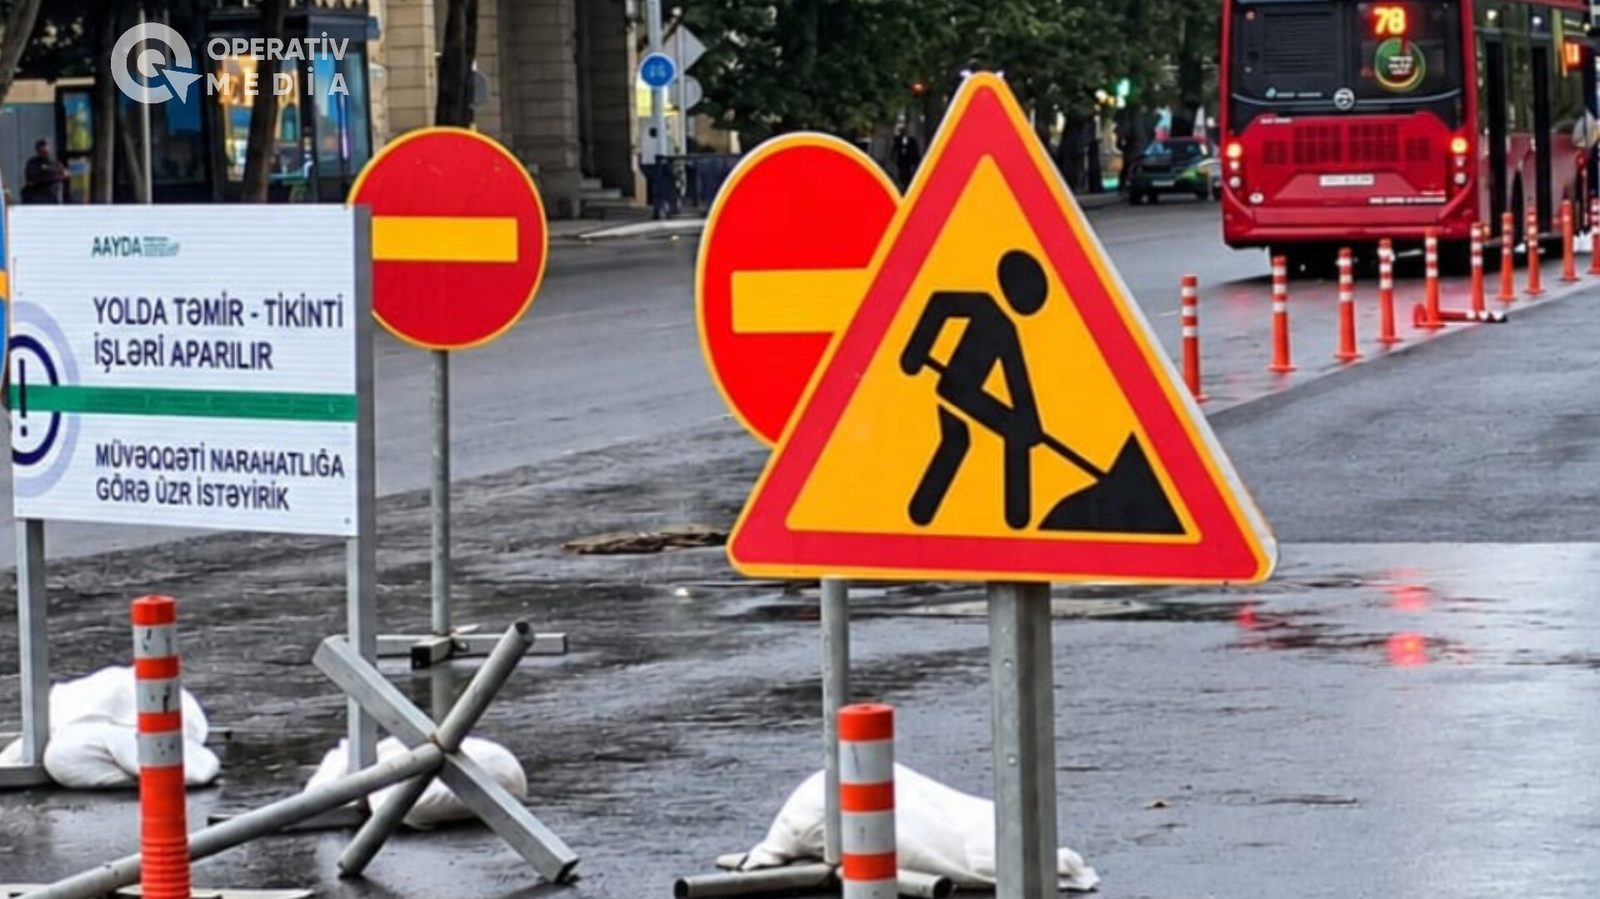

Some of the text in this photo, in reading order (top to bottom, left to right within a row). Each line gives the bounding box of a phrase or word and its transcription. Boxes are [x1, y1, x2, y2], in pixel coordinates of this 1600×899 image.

[1373, 6, 1406, 35] 78
[91, 235, 142, 257] AAYDA
[94, 296, 168, 326] YOLDA
[173, 290, 244, 327] TƏMİR
[264, 292, 343, 328] TİKİNTİ
[94, 332, 273, 373] İŞLƏRİ APARILIR
[96, 440, 345, 478] MÜVƏQQƏTİ NARAHATLIĞA
[96, 473, 290, 511] GÖRƏ ÜZR İSTƏYİRİK
